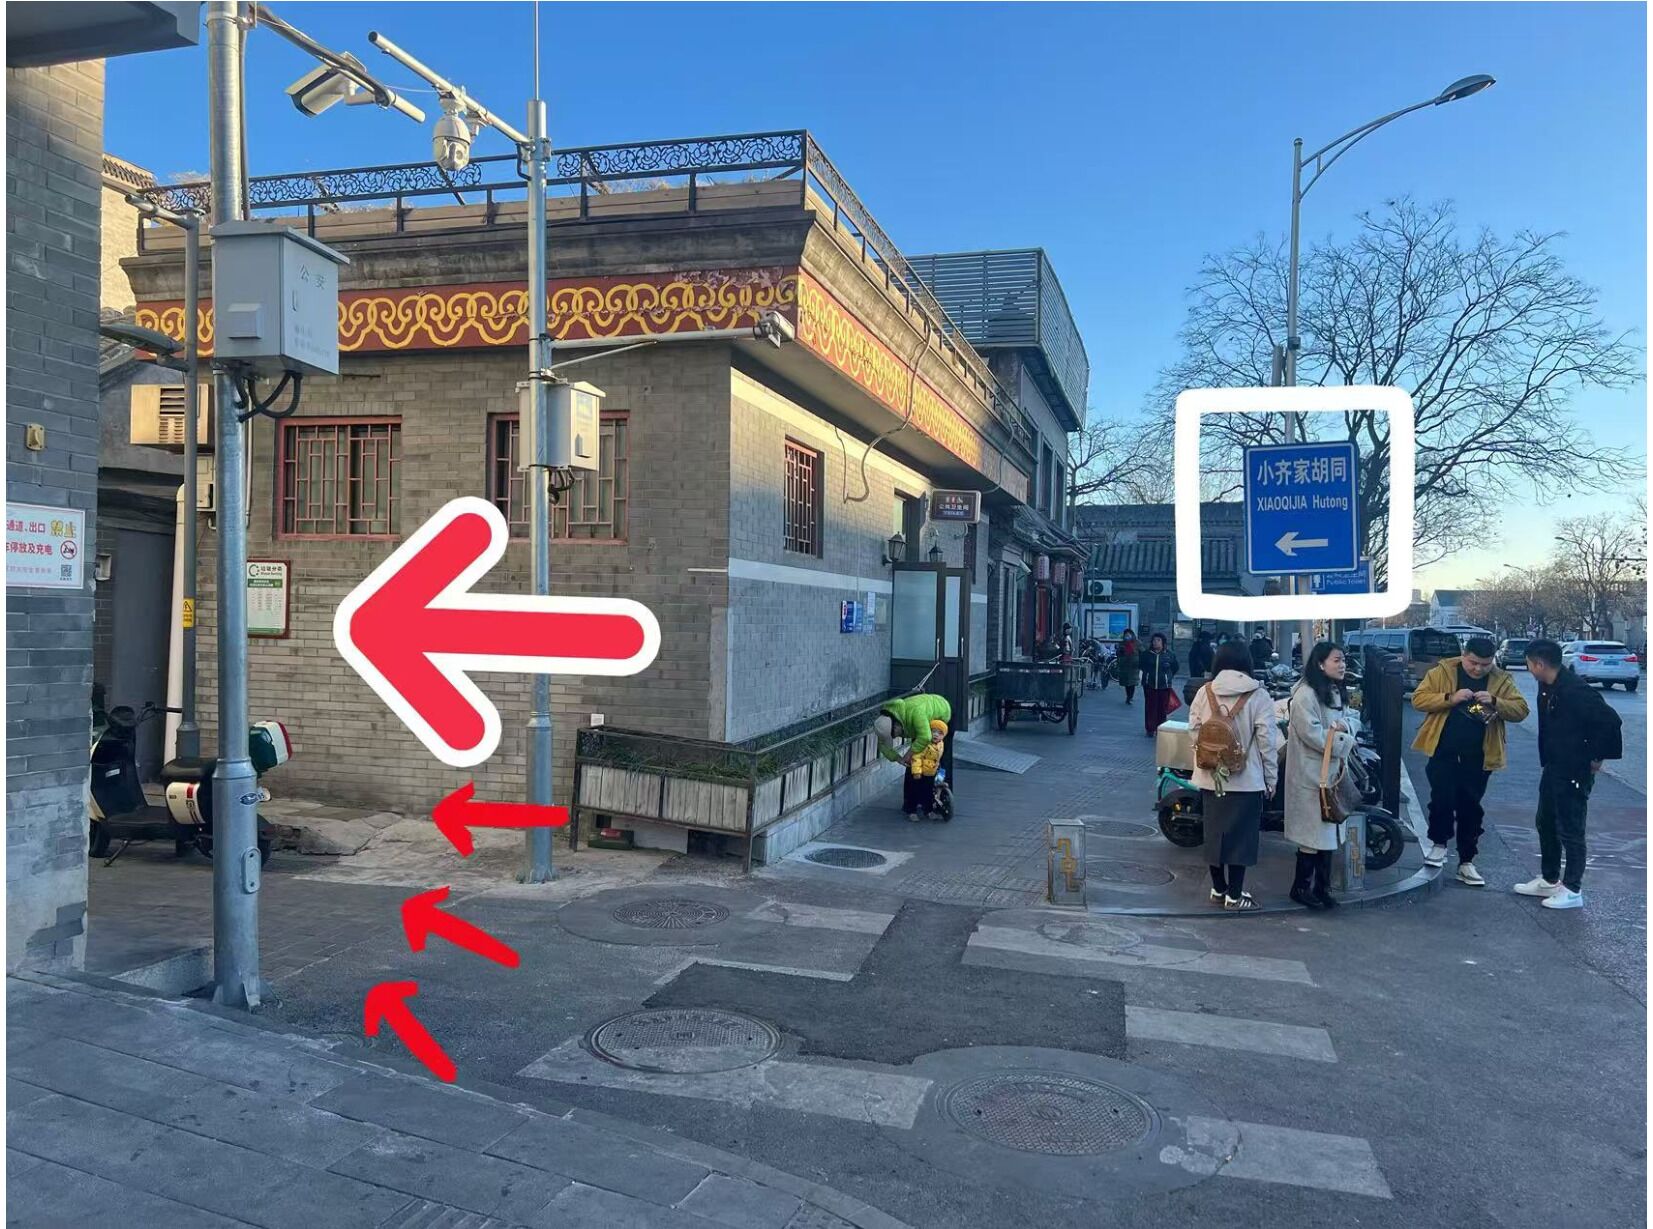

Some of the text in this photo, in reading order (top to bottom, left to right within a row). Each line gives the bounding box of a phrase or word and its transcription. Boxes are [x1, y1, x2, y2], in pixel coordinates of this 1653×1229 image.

[300, 264, 327, 290] 公安
[1257, 457, 1346, 485] 小齐家胡同
[1257, 494, 1348, 511] XIAOQIJIA Hutong
